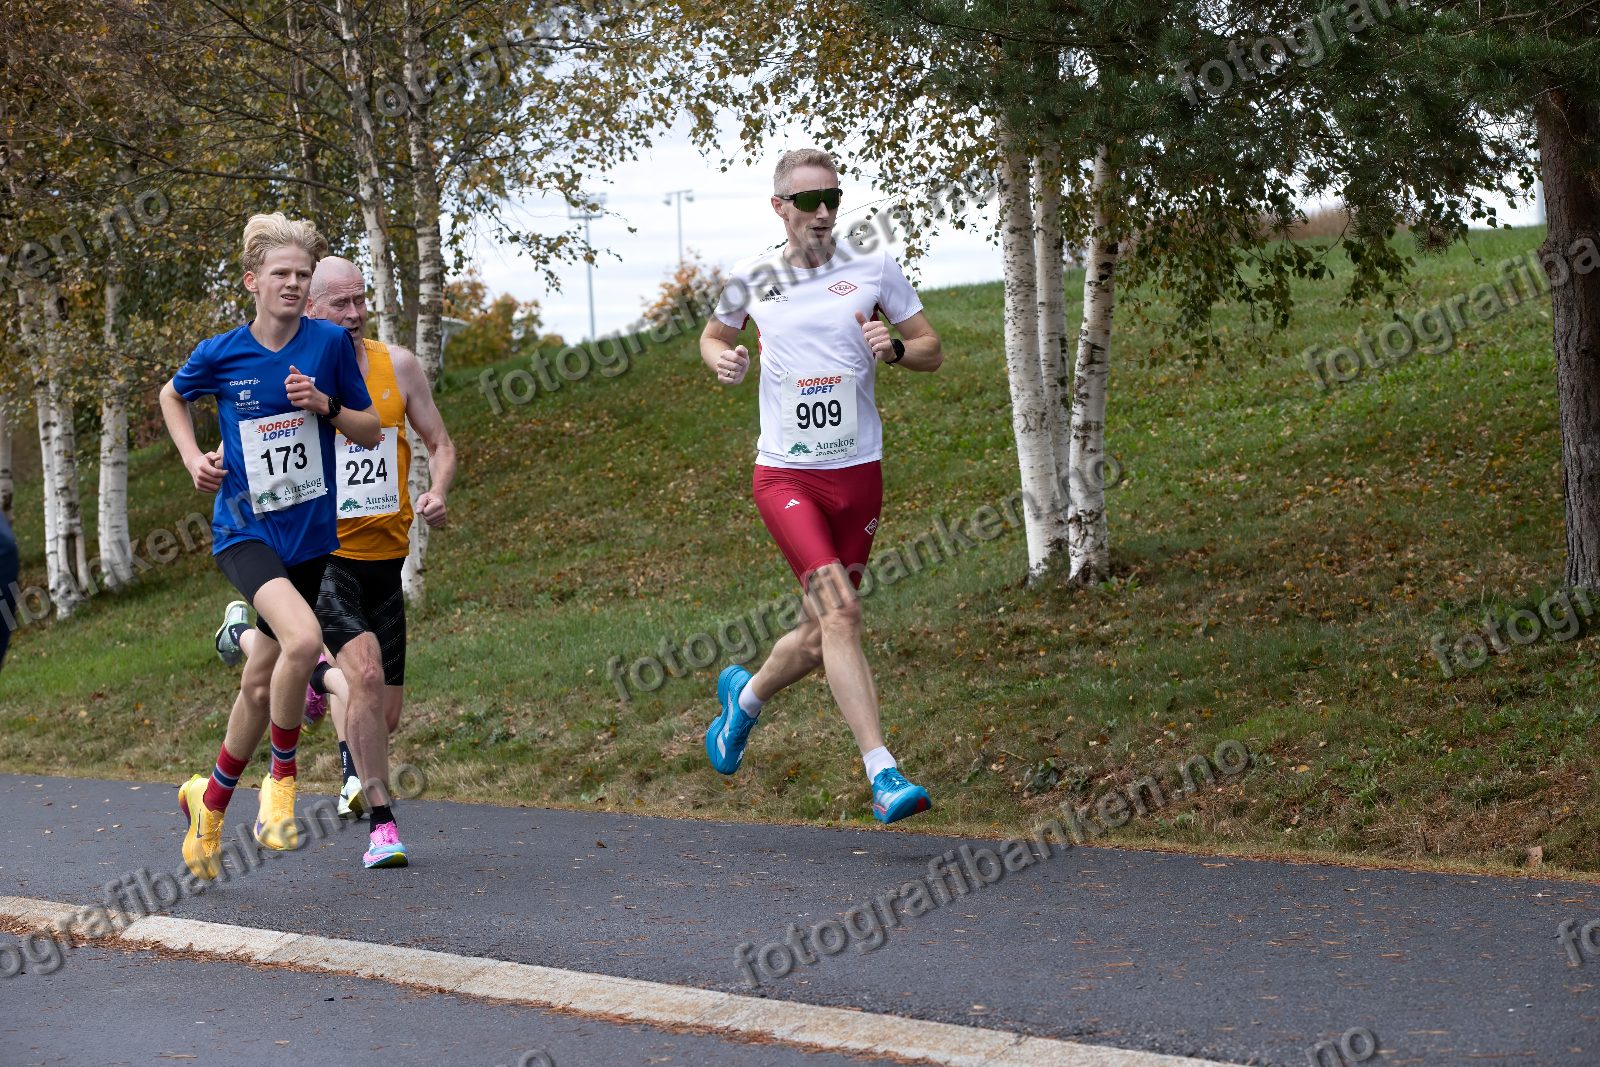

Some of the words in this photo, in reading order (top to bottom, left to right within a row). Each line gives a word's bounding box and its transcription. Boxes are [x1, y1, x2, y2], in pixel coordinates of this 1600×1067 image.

[797, 376, 842, 387] NORGES
[801, 385, 835, 395] LØPET
[796, 399, 842, 429] 909
[257, 417, 305, 434] NORGES
[262, 427, 299, 442] LØPET
[349, 443, 381, 454] LØT
[815, 438, 855, 450] Aurskog
[260, 443, 308, 475] 173
[345, 457, 388, 486] 224
[284, 477, 322, 496] Aurskog
[365, 494, 398, 505] Aurskog
